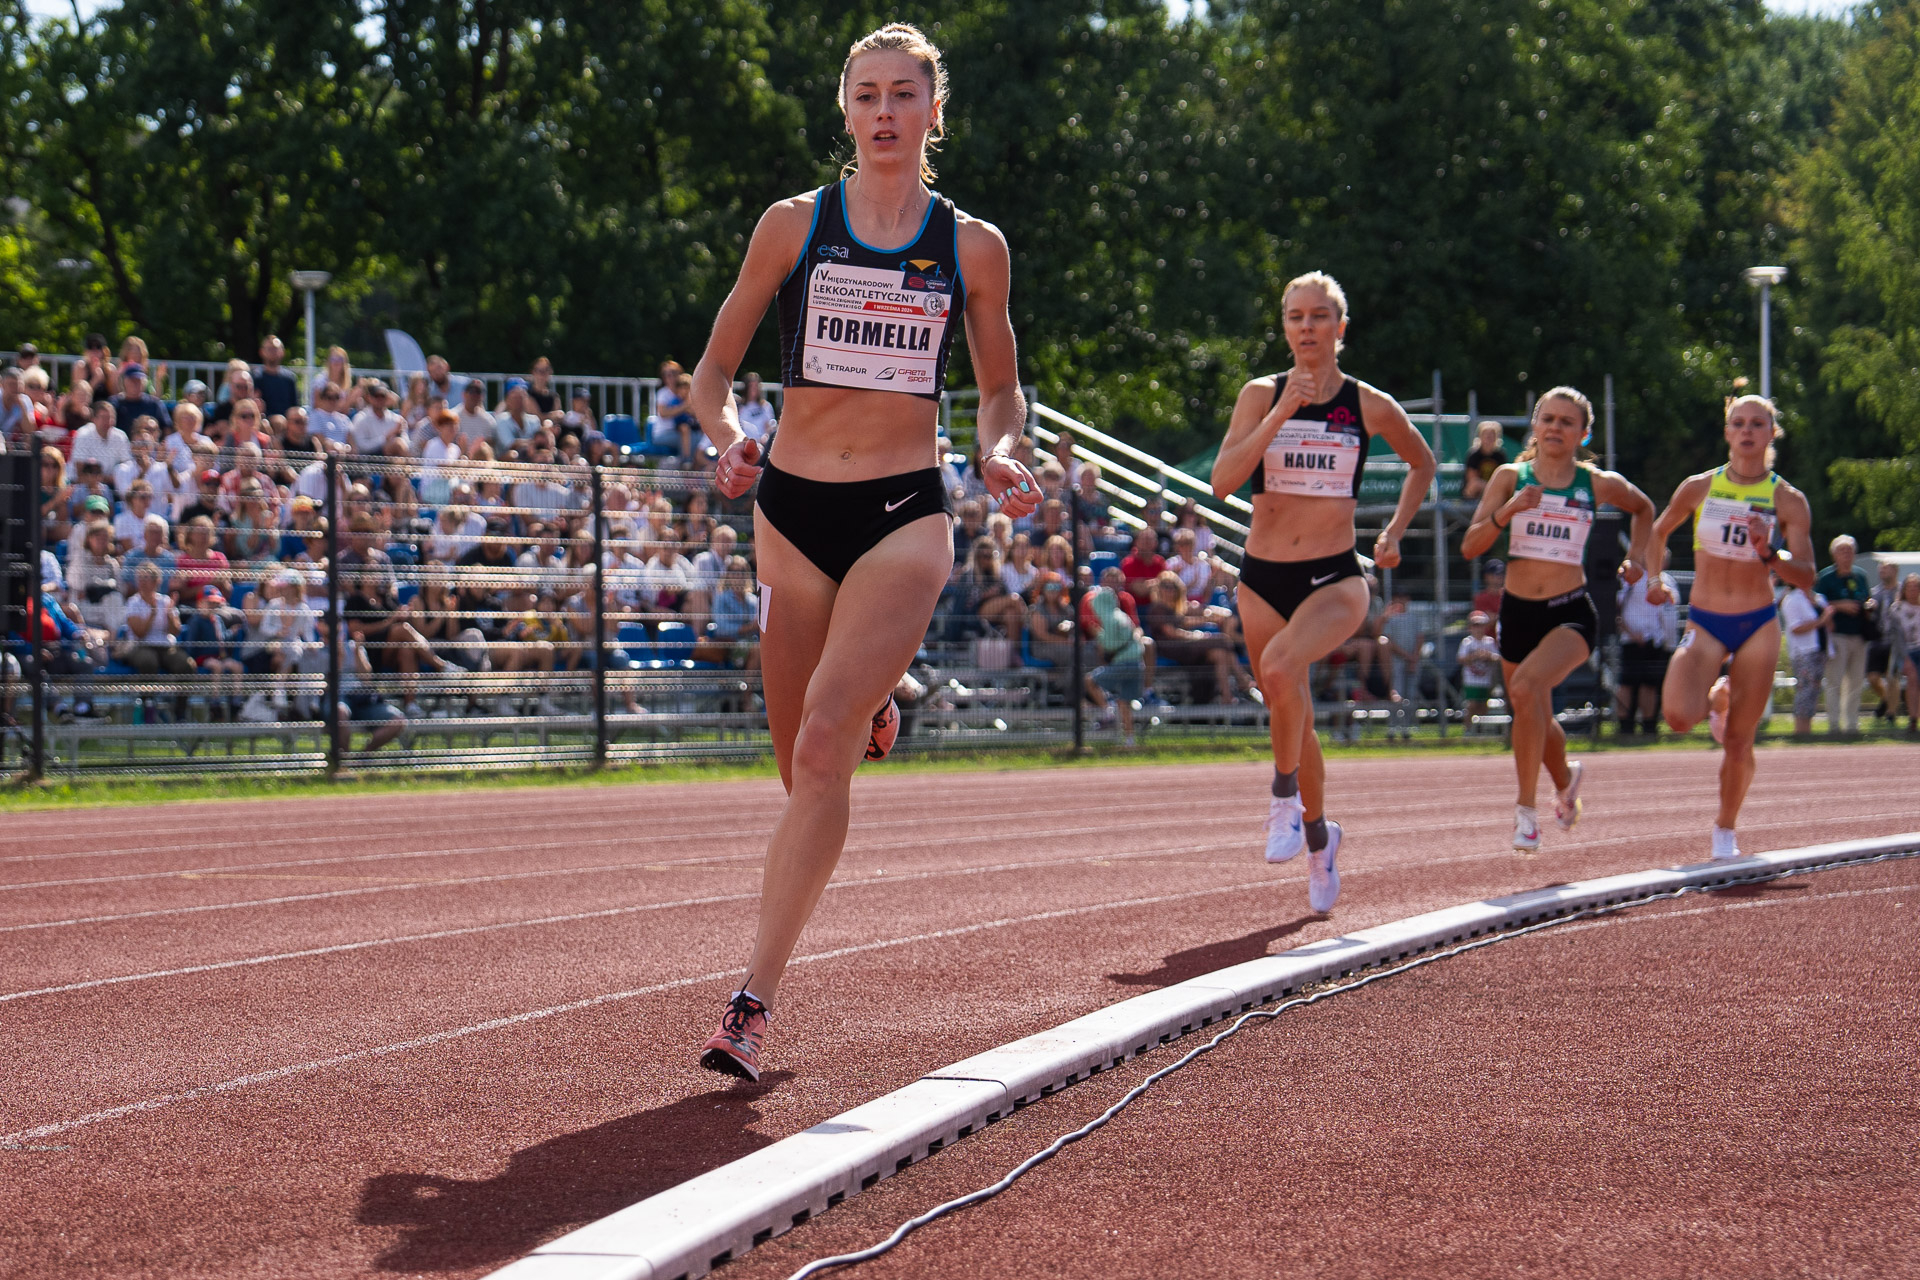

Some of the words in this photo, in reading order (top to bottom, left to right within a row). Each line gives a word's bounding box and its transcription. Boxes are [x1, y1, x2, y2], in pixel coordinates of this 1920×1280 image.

[815, 269, 829, 281] IV
[828, 276, 894, 289] MIĘDZYNARODOWY
[814, 284, 917, 304] LEKKOATLETYCZNY
[812, 300, 862, 310] LUDWICHOWSKIEGO
[816, 315, 932, 352] FORMELLA
[826, 363, 867, 375] TETRAPUR
[1284, 452, 1337, 470] HAUKE
[1526, 521, 1571, 540] GAJDA
[1721, 522, 1748, 546] 15
